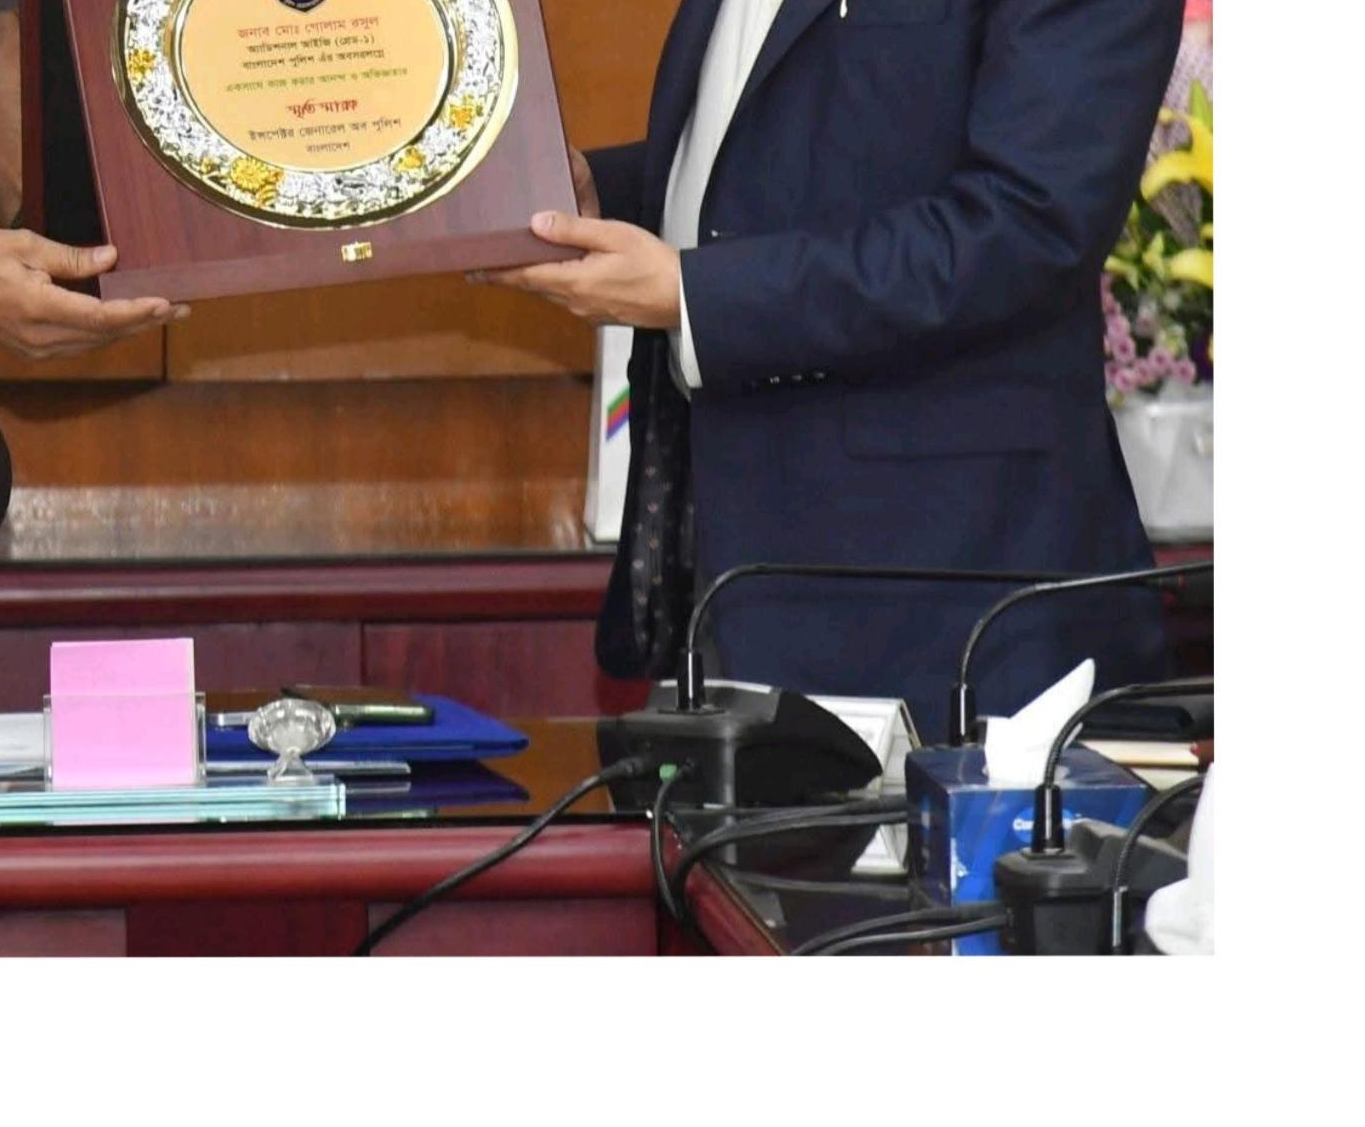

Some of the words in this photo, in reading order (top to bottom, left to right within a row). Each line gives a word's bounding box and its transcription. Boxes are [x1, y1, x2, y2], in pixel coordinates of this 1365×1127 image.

[237, 26, 270, 39] জনাব
[275, 24, 300, 37] মোঃ
[305, 20, 346, 35] গোলাম
[242, 58, 285, 71] বাংলাদেশ
[289, 55, 315, 68] পুলিশ
[299, 123, 346, 139] জেনারেল
[372, 117, 402, 132] পুলিশ
[306, 141, 350, 153] বাংলাদেশ
